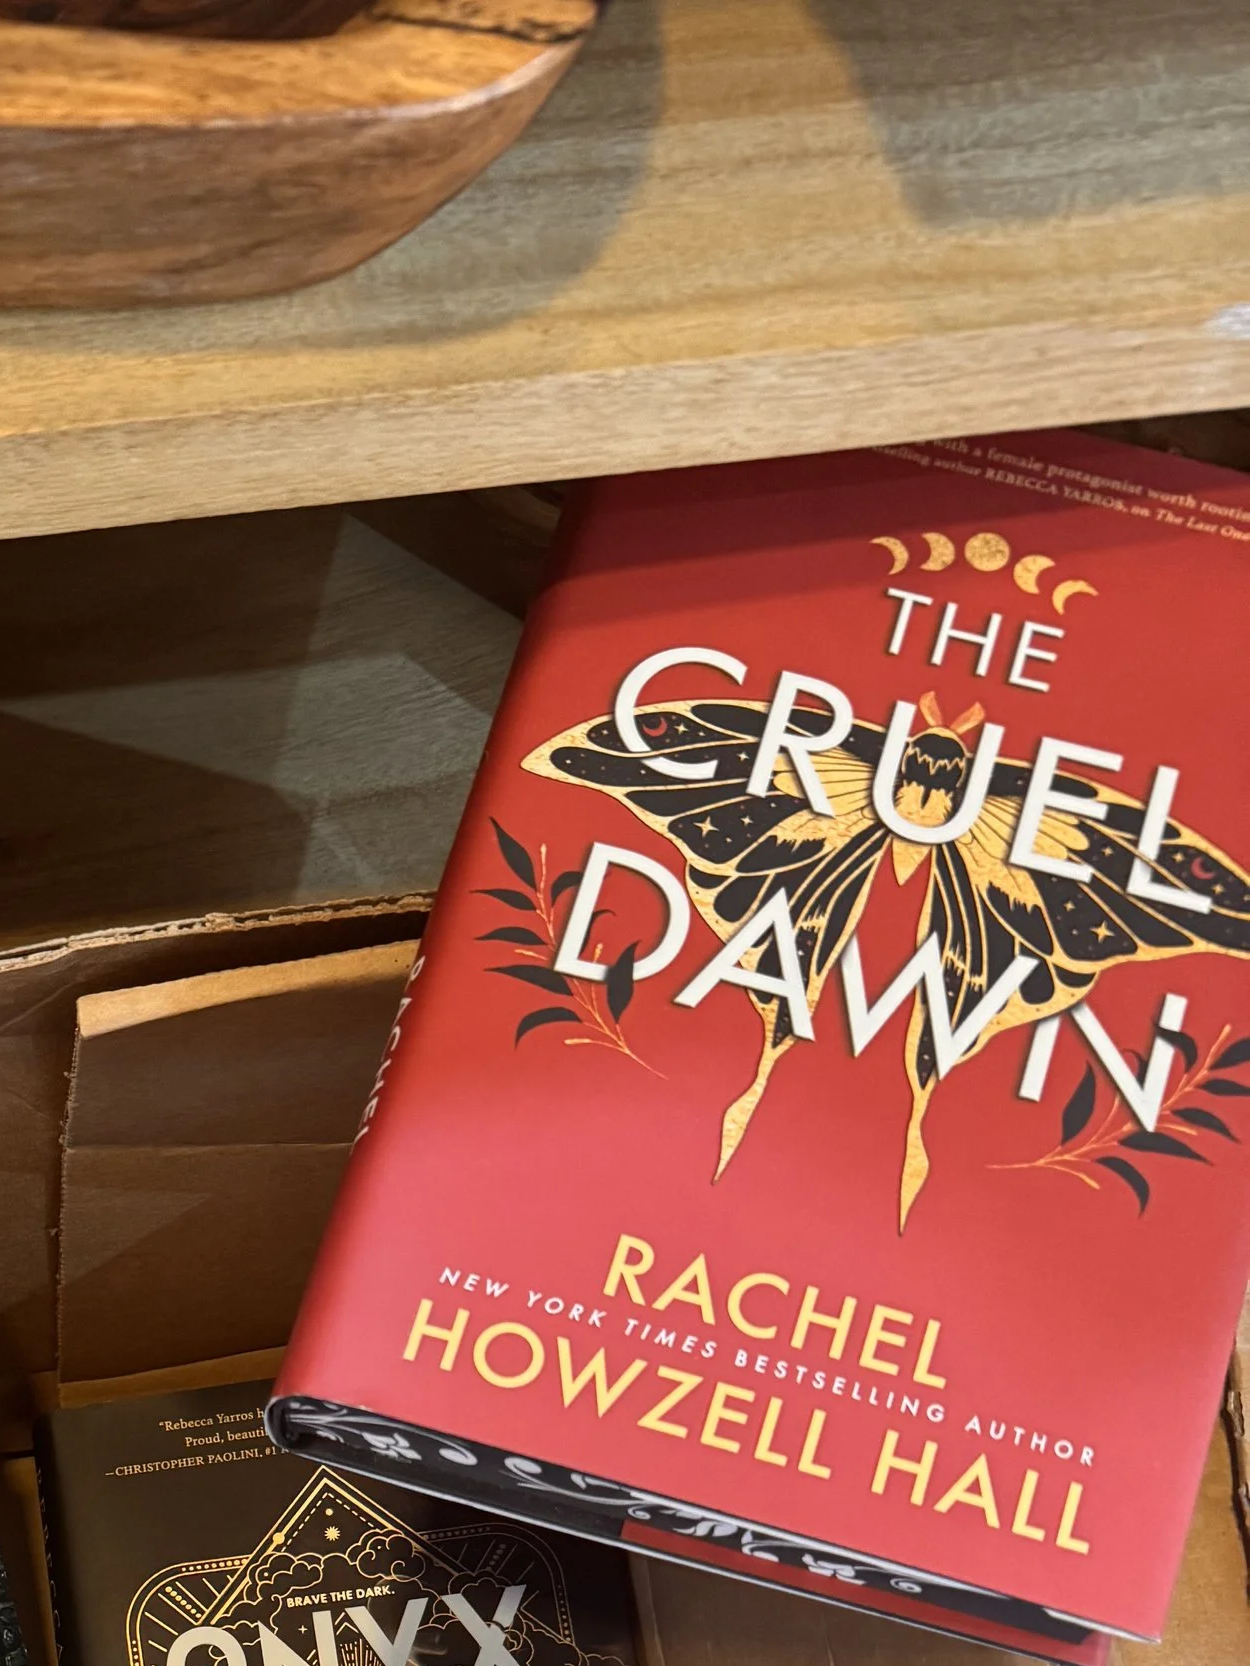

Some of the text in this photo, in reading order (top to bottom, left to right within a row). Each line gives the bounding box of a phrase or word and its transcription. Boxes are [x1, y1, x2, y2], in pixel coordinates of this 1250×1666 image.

[985, 467, 1058, 496] REBECCA
[1130, 504, 1150, 518] on
[1154, 508, 1184, 526] The
[1186, 516, 1218, 534] Last
[987, 447, 1044, 471] female
[1047, 463, 1144, 496] protagonist
[1147, 487, 1198, 509] worth
[1200, 500, 1250, 523] rootin
[887, 587, 1065, 692] THE
[614, 646, 1212, 914] CRUEL
[553, 841, 1187, 1132] DAWN
[603, 1233, 947, 1390] RACHEL
[216, 1412, 254, 1424] Yarros
[439, 1266, 1095, 1467] NEW YORK TIMES BESTSELLING AUTHOR
[185, 1427, 265, 1447] Proud, beauti
[402, 1298, 1090, 1556] HOWZELL HALL
[286, 1585, 395, 1608] BRAVE THE DARK.
